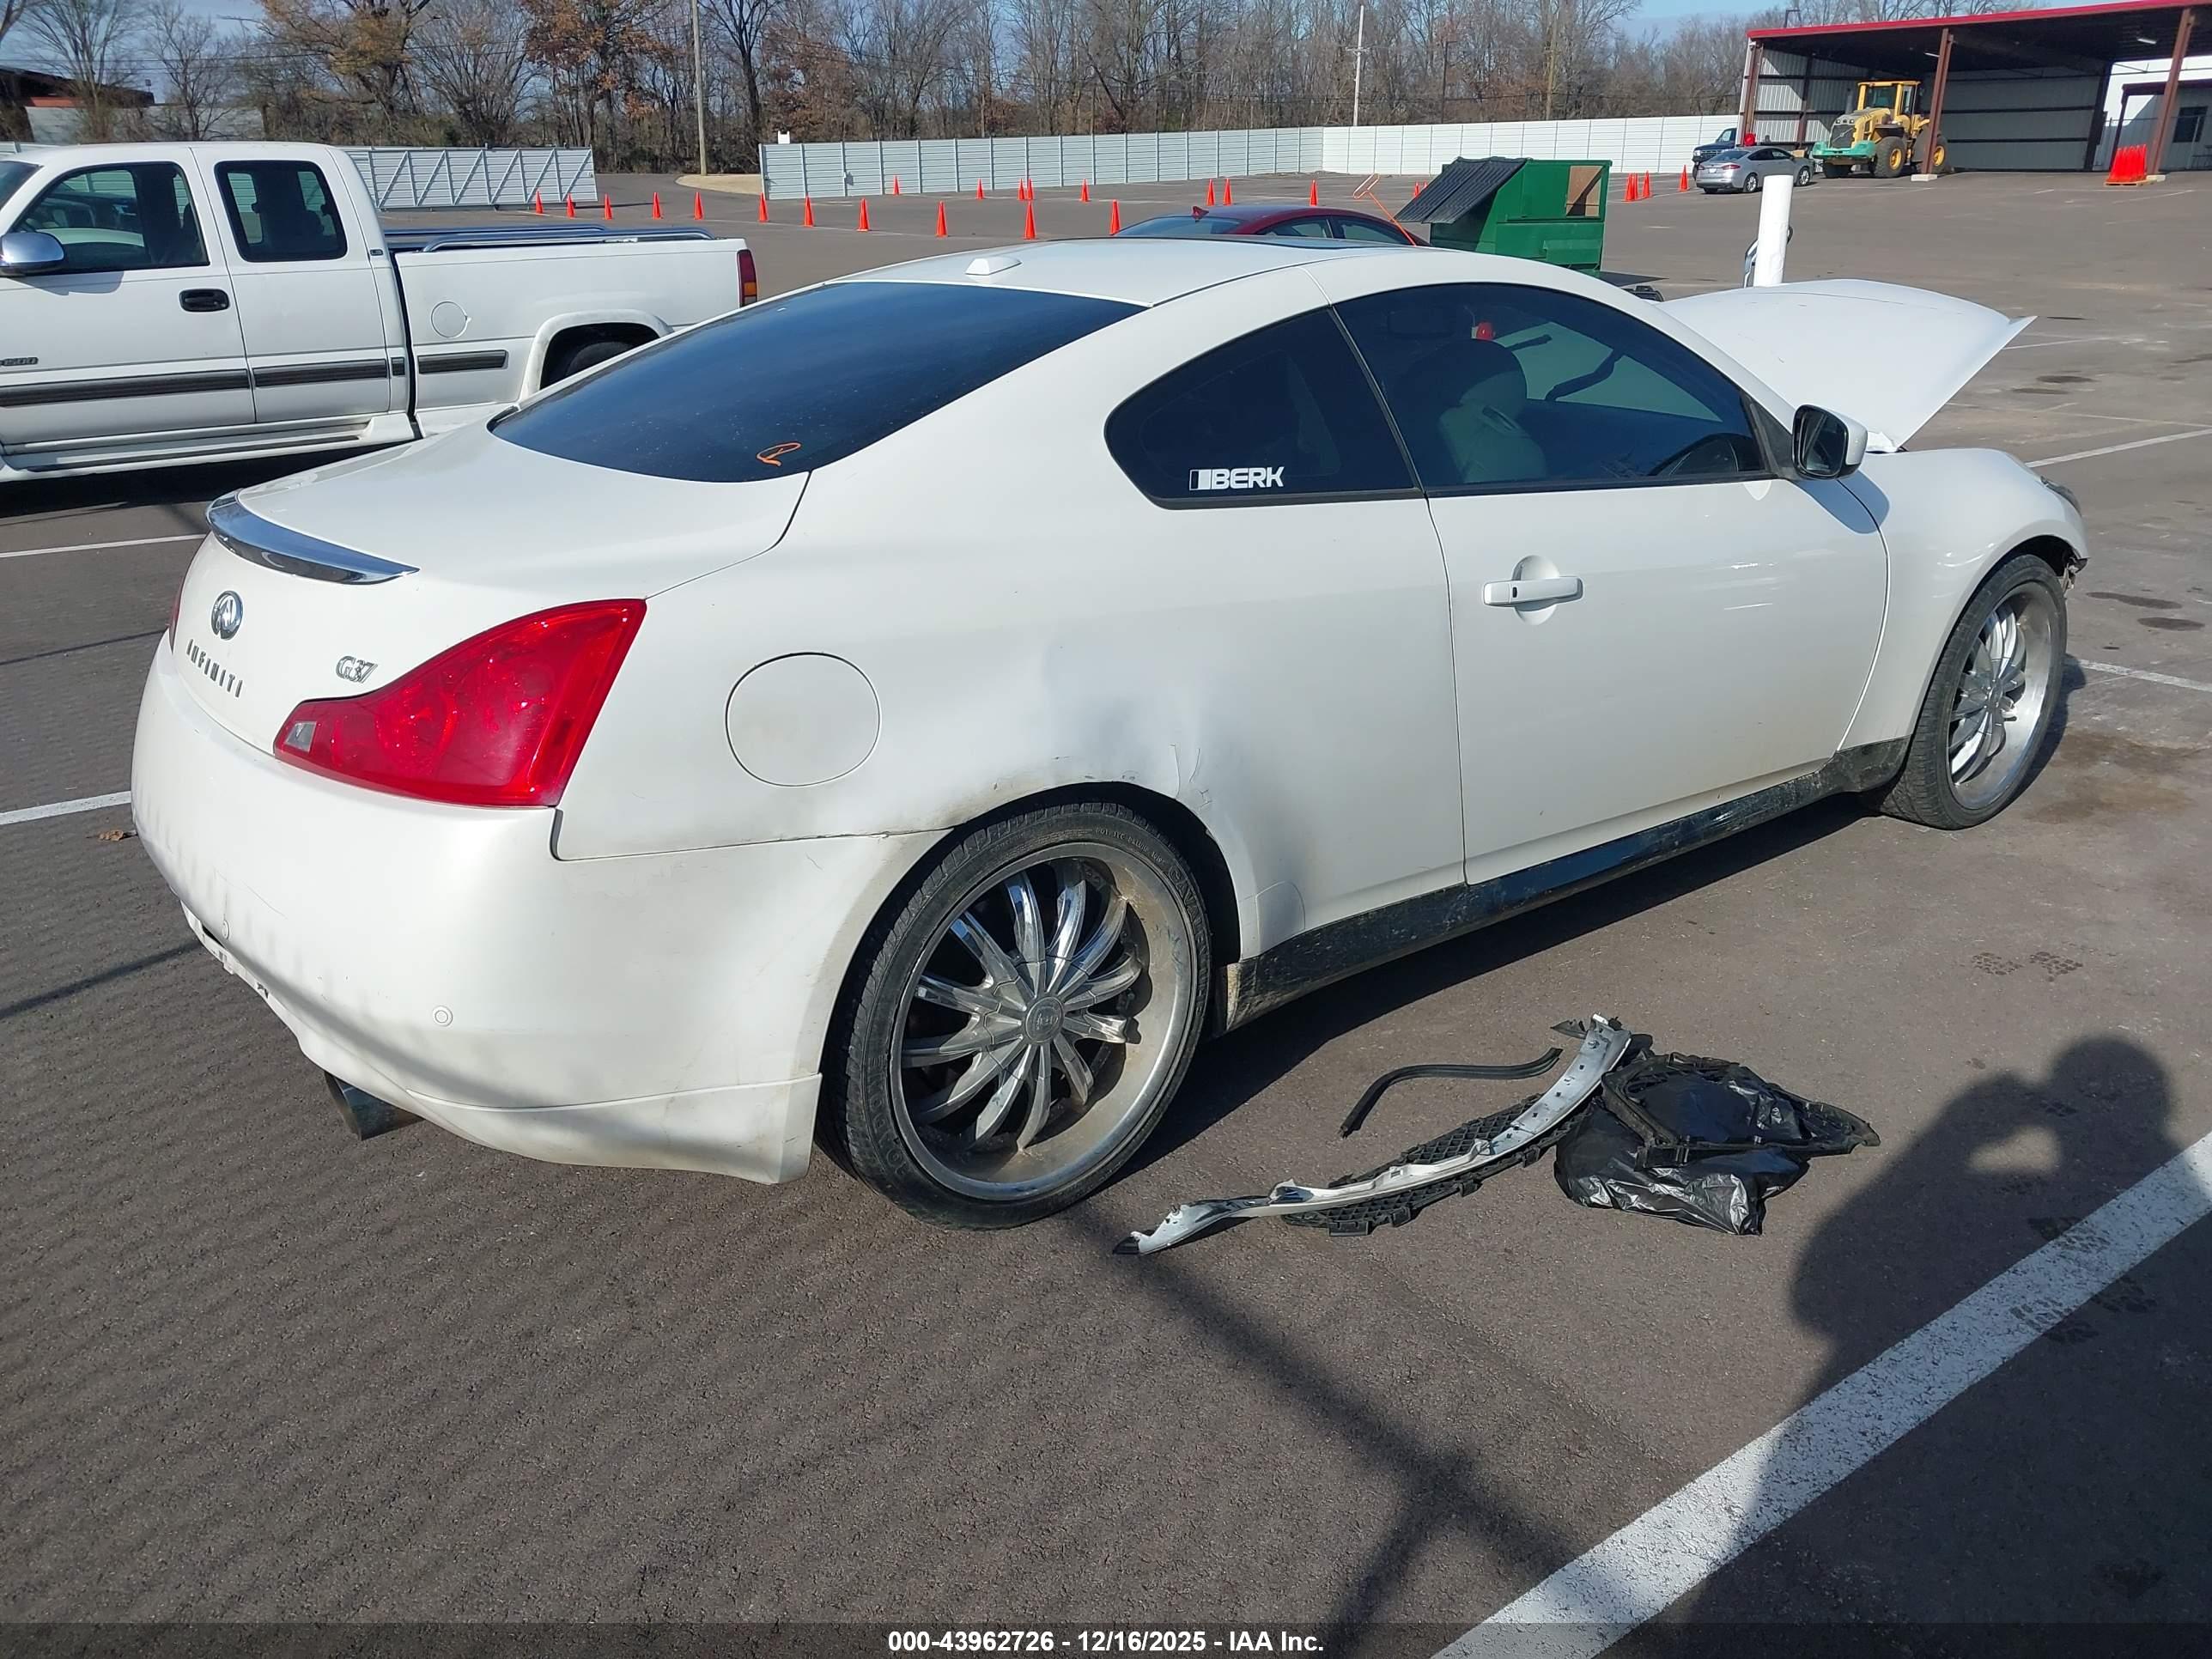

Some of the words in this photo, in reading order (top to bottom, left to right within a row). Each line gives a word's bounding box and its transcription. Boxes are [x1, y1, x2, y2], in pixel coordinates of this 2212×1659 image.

[1211, 466, 1285, 490] BERK
[185, 638, 243, 698] INFINITI
[335, 655, 378, 684] G37
